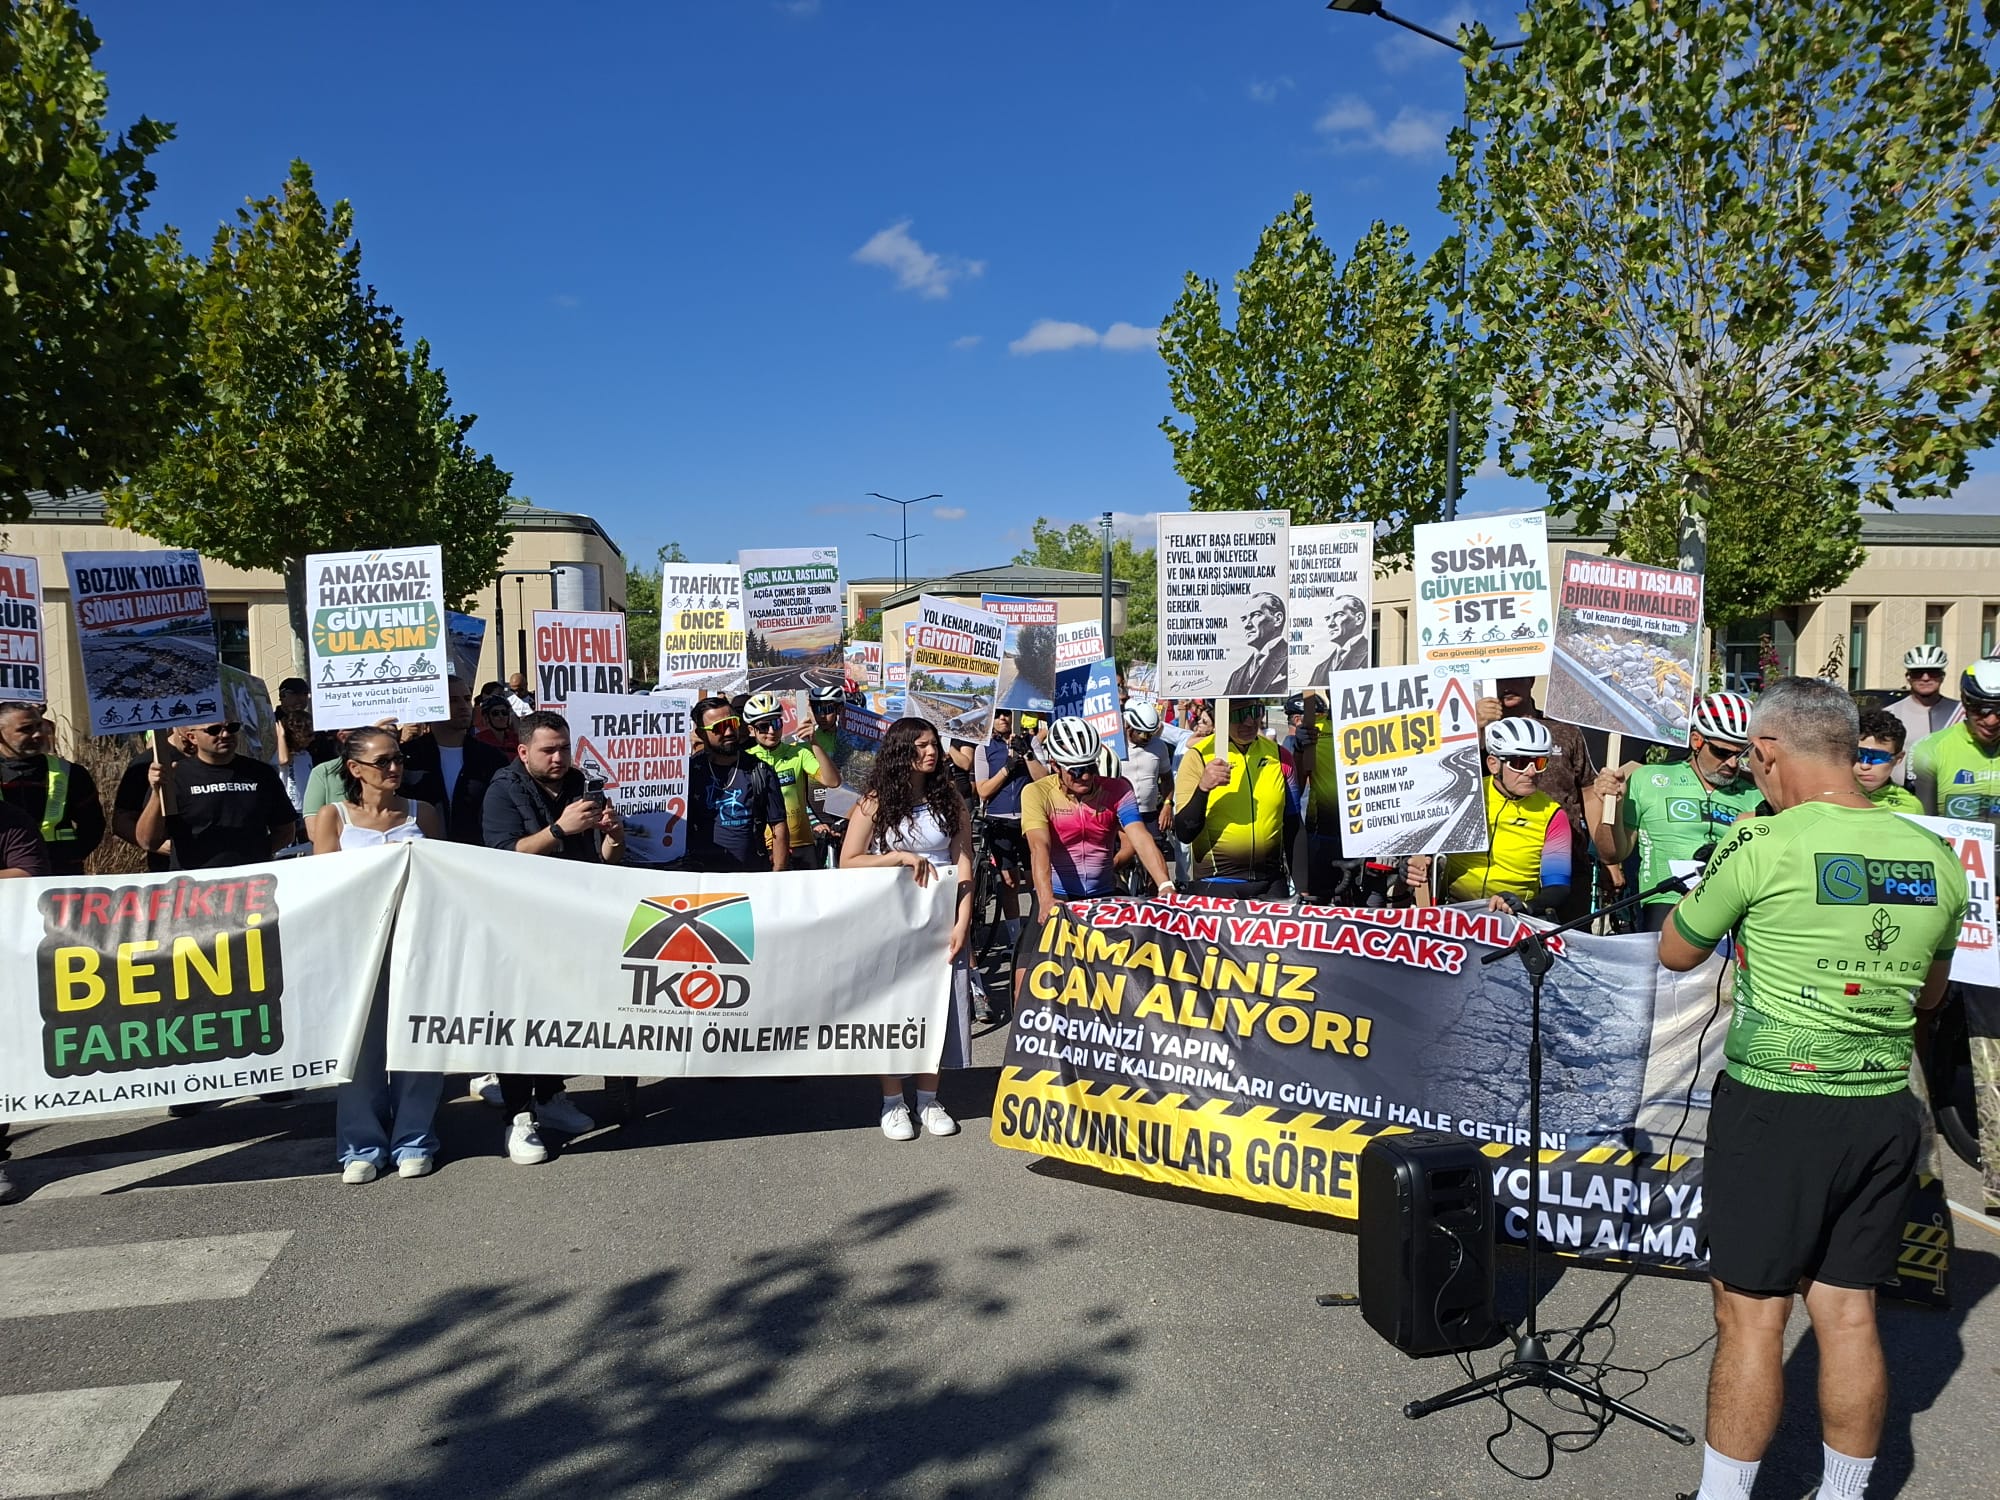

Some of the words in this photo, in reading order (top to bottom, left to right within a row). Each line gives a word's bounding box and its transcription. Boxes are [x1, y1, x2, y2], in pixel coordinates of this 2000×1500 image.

[1209, 533, 1231, 549] BAŞA
[1234, 532, 1276, 546] GELMEDEN
[1298, 543, 1317, 559] BAŞA
[1319, 542, 1358, 556] GELMEDEN
[1167, 551, 1193, 565] EVVEL,
[1195, 550, 1211, 563] ONU
[1214, 548, 1258, 562] ÖNLEYECEK
[1301, 557, 1341, 570] ÖNLEYECEK
[1431, 543, 1536, 575] SUSMA,
[75, 567, 140, 594] BOZUK
[140, 564, 200, 588] YOLLAR
[319, 560, 430, 585] ANAYASAL
[748, 572, 771, 587] ŞANS,
[772, 570, 795, 583] KAZA,
[1167, 567, 1177, 580] VE
[1180, 567, 1195, 579] ONA
[1198, 566, 1221, 581] KARŞI
[1223, 565, 1276, 579] SAVUNULACAK
[1309, 570, 1358, 584] SAVUNULACAK
[1570, 561, 1637, 590] DÖKÜLEN
[1640, 571, 1697, 599] TAŞLAR,
[320, 581, 431, 607] HAKKIMIZ:
[670, 574, 739, 595] TRAFİKTE
[754, 589, 773, 600] AÇIĞA
[774, 588, 795, 598] ÇIKMIŞ
[797, 586, 807, 596] BİR
[808, 584, 831, 596] SEBEBİN
[1167, 581, 1209, 596] ÖNLEMLERİ
[1210, 581, 1251, 597] DÜŞÜNMEK
[1298, 586, 1334, 600] DÜŞÜNMEK
[1421, 570, 1507, 601] GÜVENLİ
[1510, 570, 1547, 591] YOL
[82, 597, 133, 625] SÖNEN
[137, 591, 204, 617] HAYATLAR!
[749, 608, 785, 618] YAŞAMADA
[787, 605, 812, 617] TESADÜF
[815, 605, 839, 614] YOKTUR.
[773, 597, 813, 608] SONUCUDUR.
[986, 603, 1000, 613] YOL
[1000, 603, 1025, 613] KENARI
[1167, 597, 1202, 613] GEREKİR.
[1455, 597, 1516, 624] İSTE
[1565, 584, 1620, 610] BİRİKEN
[1624, 590, 1696, 619] İHMALLER!
[327, 602, 425, 631] GÜVENLİ
[681, 610, 725, 630] ÖNCE
[757, 616, 805, 629] NEDENSELLİK
[807, 614, 833, 625] VARDIR.
[924, 609, 939, 625] YOL
[942, 614, 1002, 642] KENARLARINDA
[1167, 616, 1204, 630] GELDİKTEN
[1205, 617, 1228, 630] SONRA
[1292, 617, 1313, 629] SONRA
[1582, 610, 1594, 621] Yol
[1595, 612, 1620, 624] kenarı
[1622, 615, 1643, 629] değil,
[1644, 619, 1661, 630] risk
[1662, 623, 1682, 634] hattı.
[328, 626, 426, 652] ULAŞIM
[537, 622, 622, 663] GÜVENLİ
[666, 635, 686, 651] CAN
[689, 631, 743, 651] GÜVENLİĞİ
[1072, 625, 1100, 640] DEĞİL
[1167, 632, 1217, 646] DÖVÜNMENİN
[922, 627, 970, 654] GİYOTİN
[974, 639, 1001, 662] DEĞİL,
[1056, 639, 1101, 660] ÇUKUR
[1167, 649, 1194, 661] YARARI
[1432, 651, 1449, 659] Can
[1450, 646, 1487, 659] güvenliği
[1488, 644, 1541, 655] ertelenemez.
[667, 652, 740, 671] İSTİYORUZ!
[916, 650, 943, 666] GÜVENLİ
[943, 654, 968, 670] BARİYER
[969, 656, 999, 676] İSTİYORUZ!
[1449, 663, 1469, 672] green
[325, 691, 351, 700] Hayat
[365, 688, 390, 697] vücut
[393, 684, 434, 695] bütünlüğü
[352, 697, 411, 708] korunmalıdır.
[1340, 684, 1376, 720] AZ
[1381, 675, 1434, 713] LAF,
[591, 710, 685, 737] TRAFİKTE
[607, 735, 685, 759] KAYBEDİLEN
[1343, 722, 1397, 766] ÇOK
[1401, 714, 1436, 755] İŞ!
[618, 761, 640, 782] HER
[644, 759, 685, 781] CANDA,
[1363, 768, 1389, 781] BAKIM
[1392, 766, 1408, 777] YAP
[620, 786, 637, 799] TEK
[638, 783, 683, 798] SORUMLU
[1364, 784, 1397, 797] ONARIM
[1399, 780, 1415, 792] YAP
[614, 800, 653, 816] ÜRÜCÜSÜ
[654, 800, 666, 814] MÜ
[1366, 797, 1401, 813] DENETLE
[1367, 812, 1399, 829] GÜVENLİ
[1400, 809, 1426, 823] YOLLAR
[1427, 804, 1450, 819] SAĞLA
[1868, 861, 1935, 886] green
[1885, 878, 1936, 896] Pedal
[52, 879, 270, 926] TRAFİKTE
[1094, 904, 1219, 941] ZAMAN
[1230, 919, 1465, 972] YAPILACAK?
[54, 913, 266, 1012] BENİ
[1038, 906, 1318, 1002] İHMALİNİZ
[1817, 958, 1921, 972] CORTADO
[621, 963, 751, 1010] TKÖD
[696, 1009, 721, 1017] ÖNLEME
[1029, 960, 1127, 1015] CAN
[1134, 984, 1373, 1058] ALIYOR!
[54, 1004, 271, 1067] FARKET!
[408, 1010, 515, 1047] TRAFİK
[524, 1018, 693, 1053] KAZALARINI
[702, 1021, 809, 1053] ÖNLEME
[817, 1016, 926, 1050] DERNEĞİ
[1019, 1006, 1144, 1051] GÖREVİNİZİ
[1150, 1032, 1235, 1071] YAPIN,
[34, 1079, 177, 1110] KAZALARINI
[184, 1066, 284, 1092] ÖNLEME
[1015, 1035, 1088, 1067] YOLLARI
[1087, 1052, 1116, 1072] VE
[1120, 1057, 1273, 1099] KALDIRIMLARI
[1279, 1081, 1382, 1119] GÜVENLİ
[1388, 1103, 1452, 1132] HALE
[1458, 1119, 1567, 1150] GETİRN!
[1001, 1094, 1232, 1180] SORUMLULAR
[1246, 1131, 1355, 1200] GÖRE
[1492, 1166, 1651, 1216] YOLLARI
[1505, 1207, 1582, 1247] CAN
